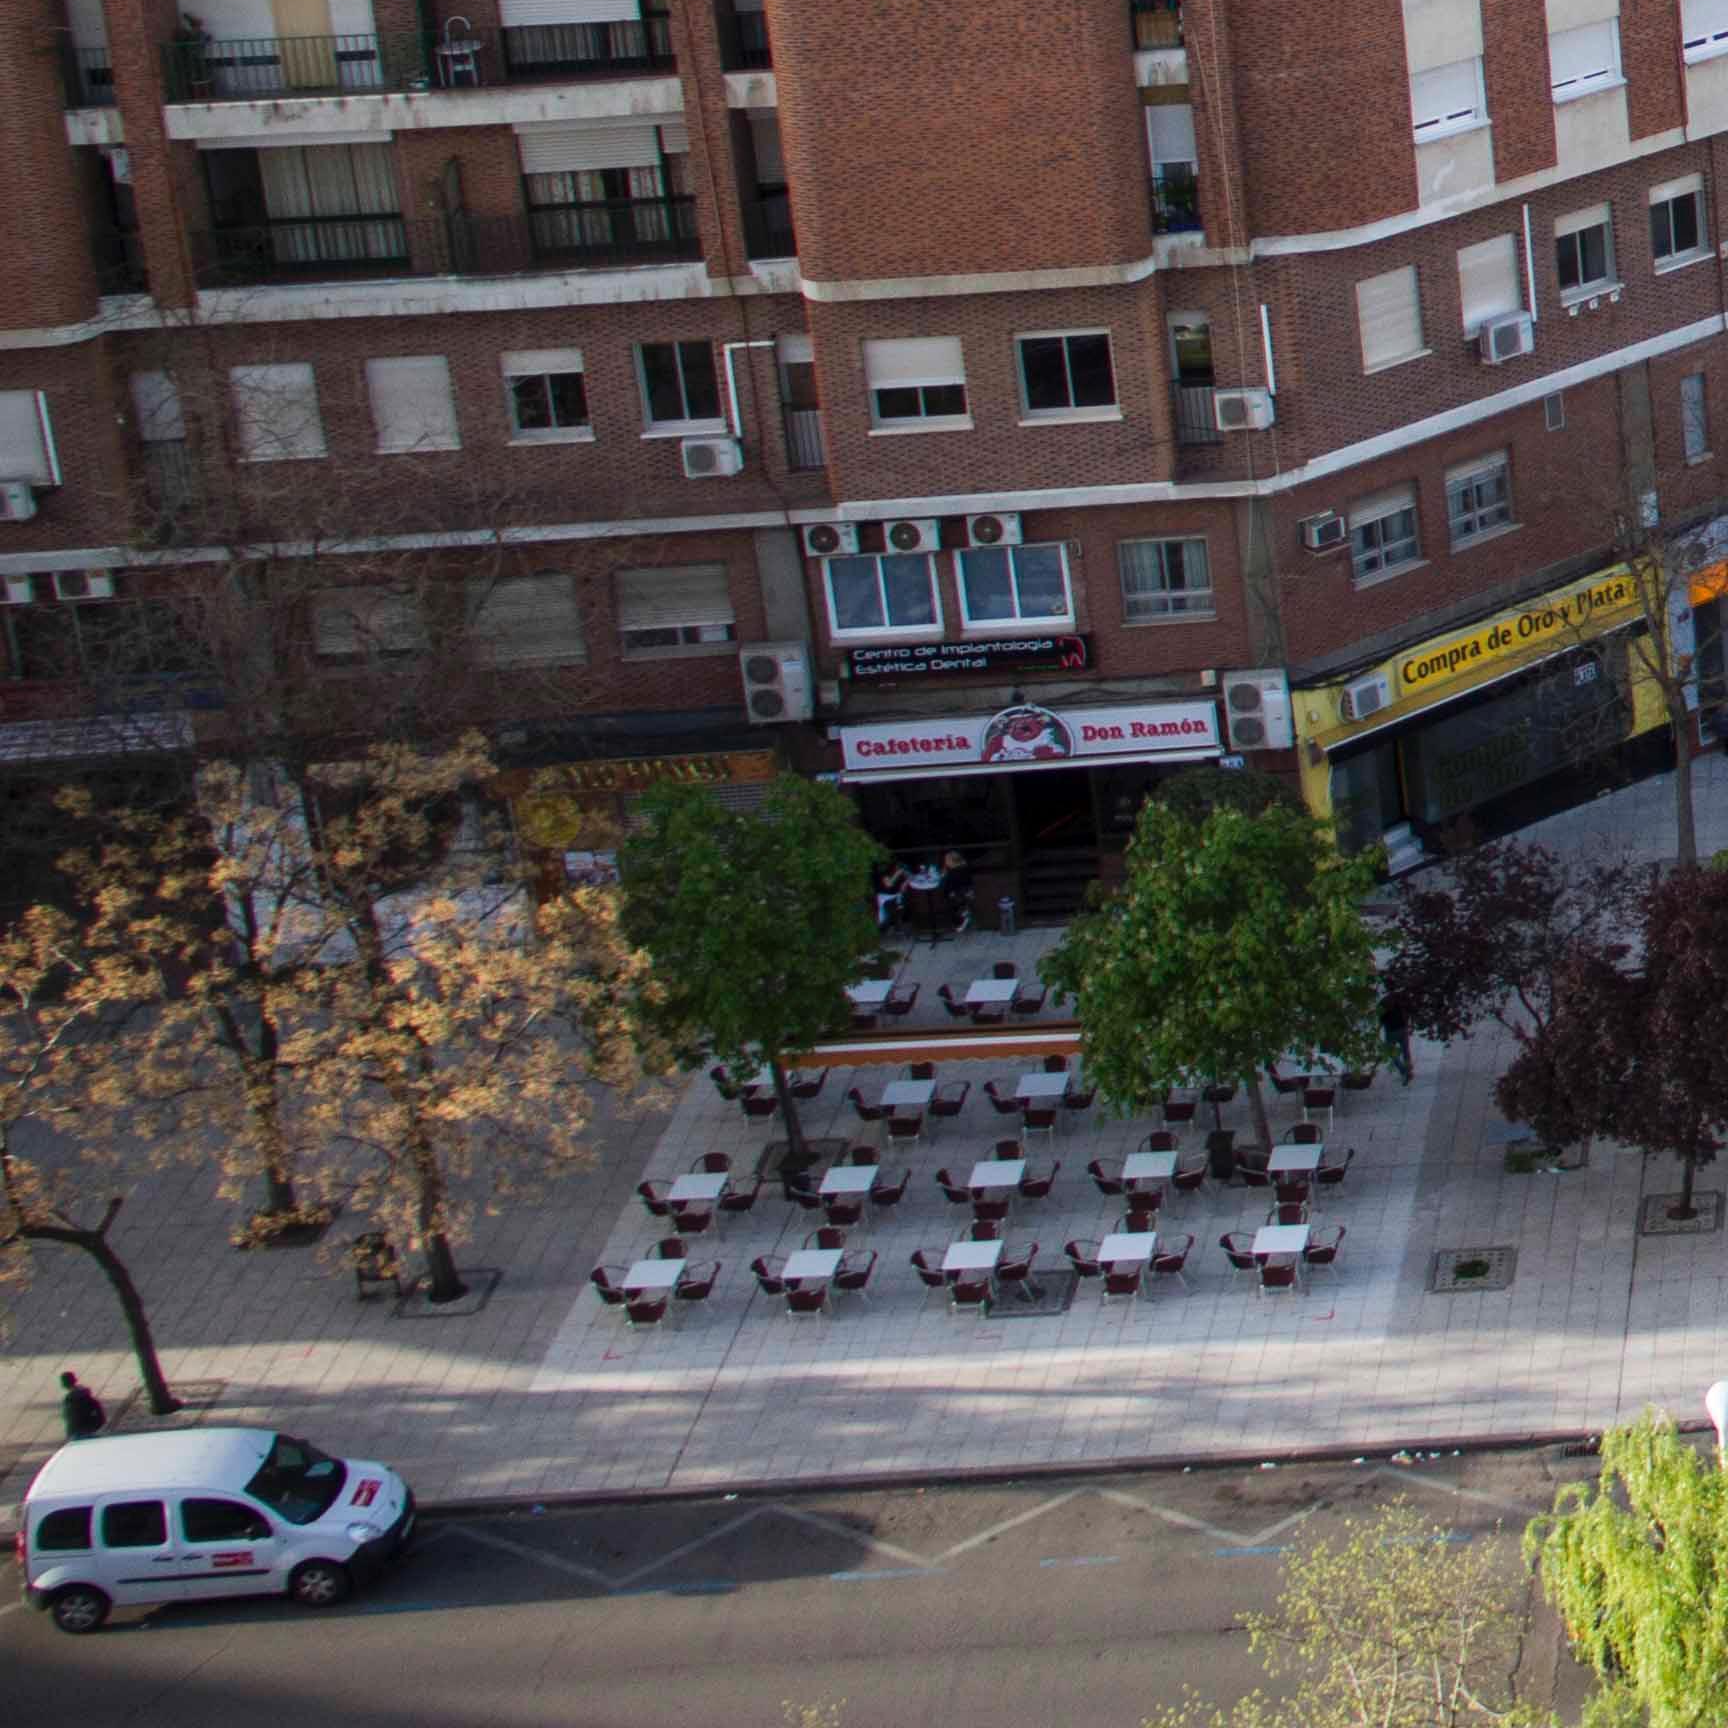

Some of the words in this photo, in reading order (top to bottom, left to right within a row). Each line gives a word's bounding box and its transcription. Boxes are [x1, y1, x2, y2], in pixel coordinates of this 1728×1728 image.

[1402, 642, 1481, 685] Compra
[1487, 627, 1513, 651] de
[1517, 610, 1555, 638] Oro
[1555, 603, 1572, 628] y
[1577, 583, 1626, 614] Plata
[853, 648, 911, 661] Centro
[915, 645, 937, 657] de
[930, 657, 988, 670] Dental
[1082, 723, 1123, 743] Don
[1130, 716, 1208, 739] Ramón
